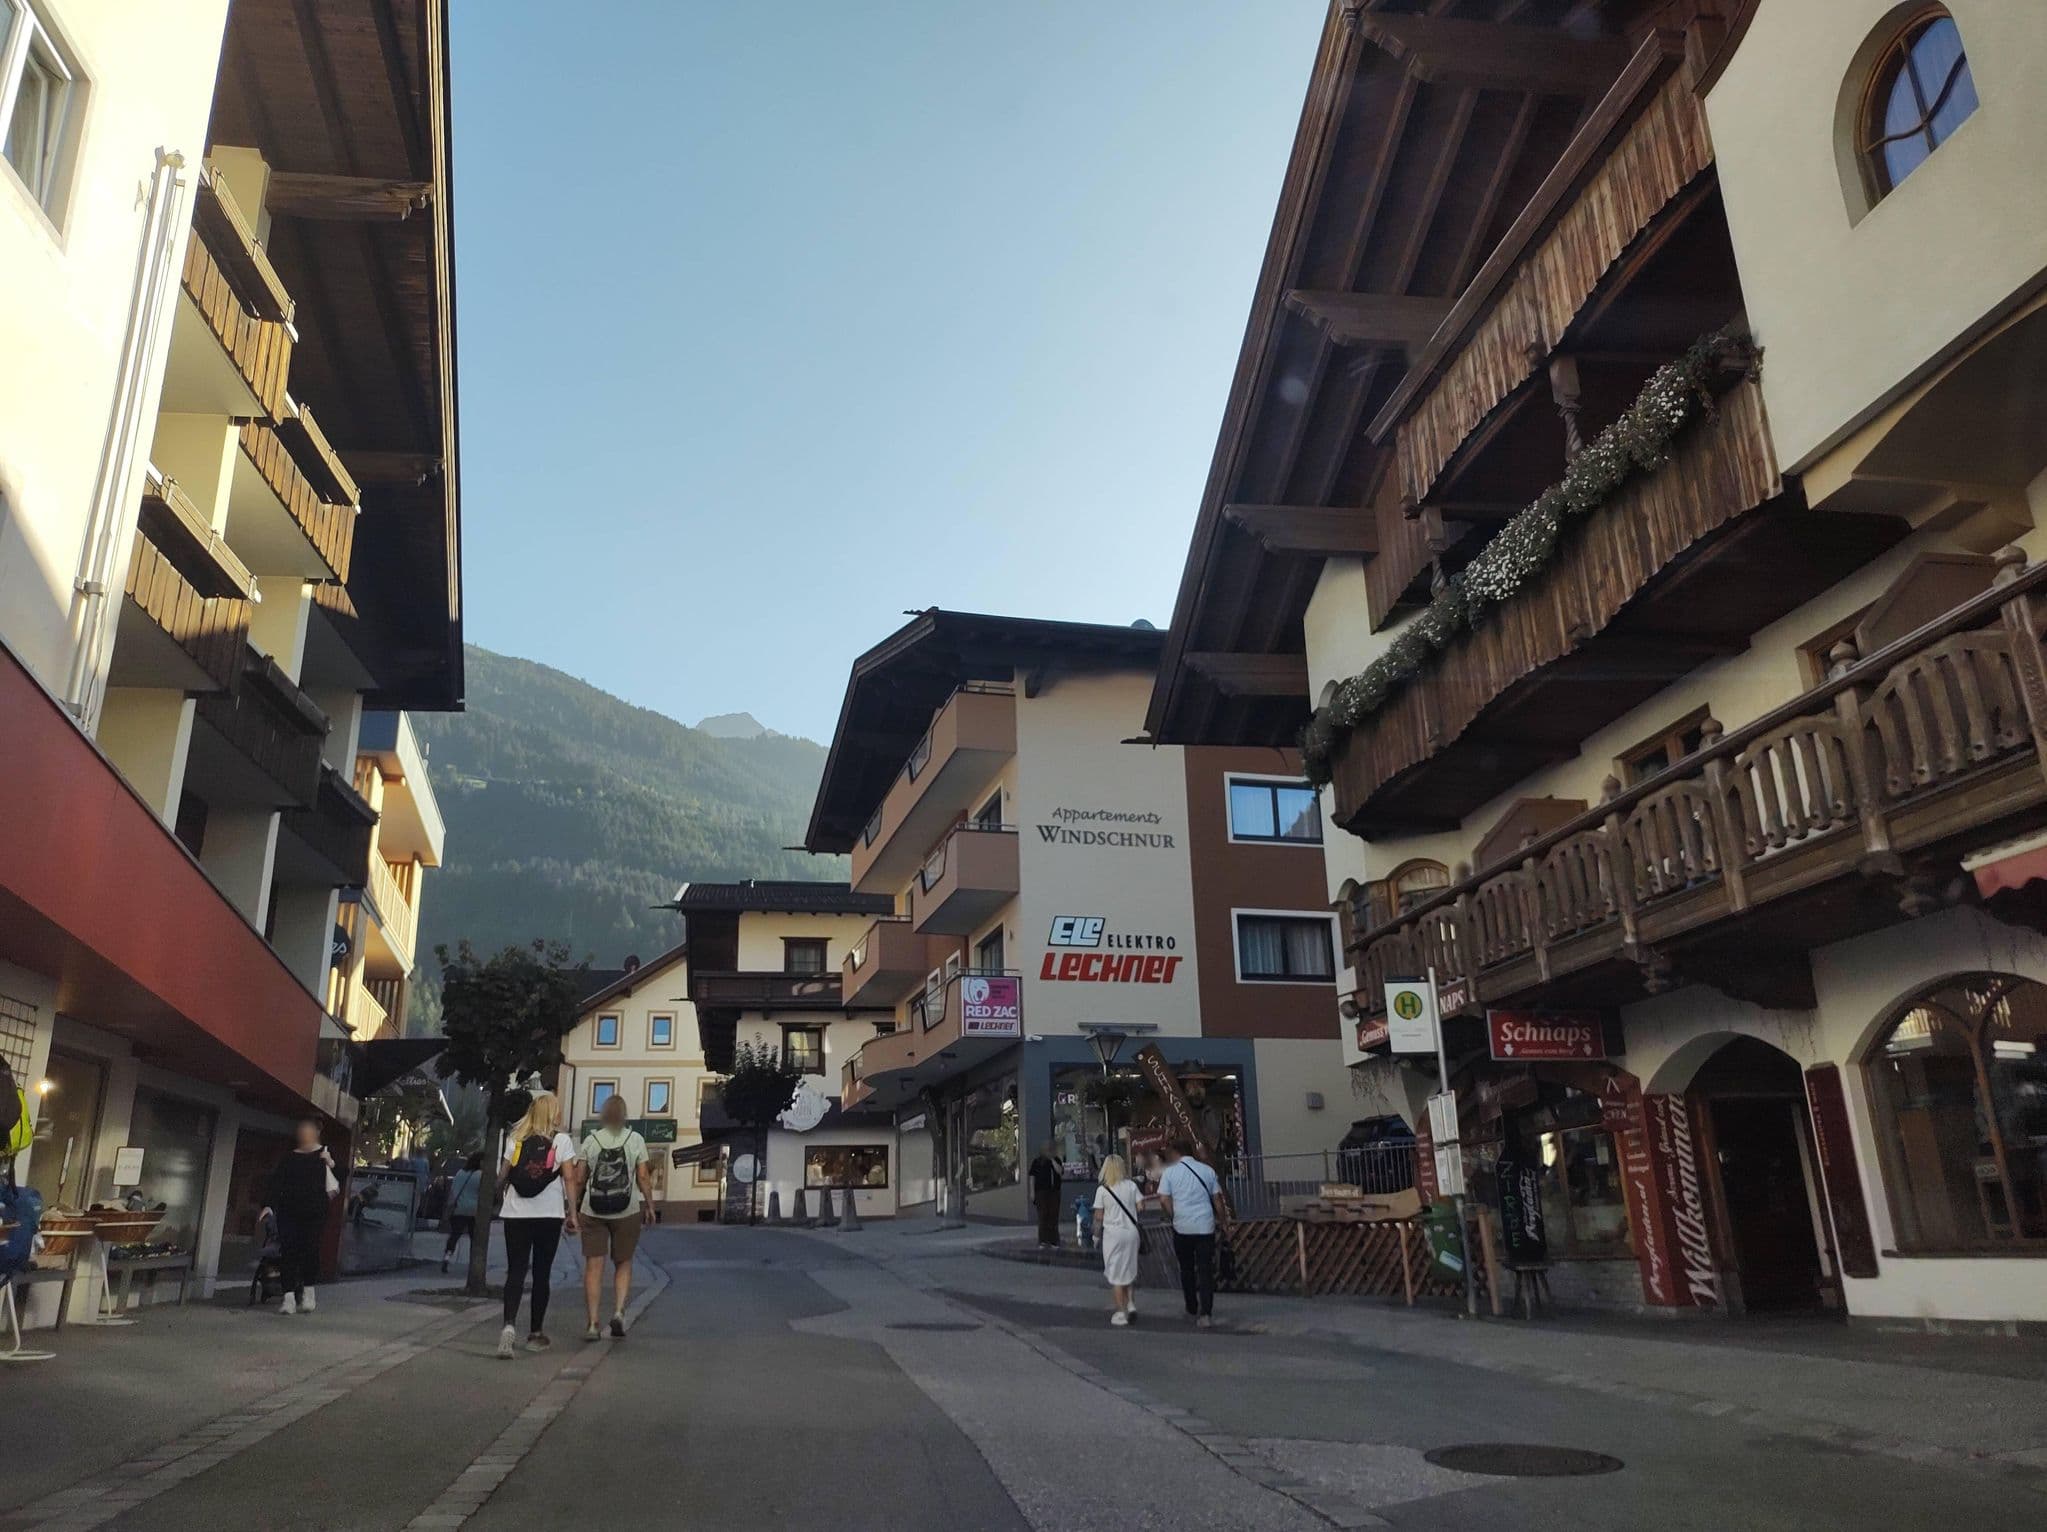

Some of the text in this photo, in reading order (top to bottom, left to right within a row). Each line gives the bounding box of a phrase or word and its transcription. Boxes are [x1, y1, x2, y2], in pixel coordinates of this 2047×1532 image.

[1052, 807, 1162, 825] Appartements
[1036, 824, 1176, 849] WINDSCHNUR
[1107, 934, 1176, 949] ELEKTRO
[966, 1005, 1017, 1018] RED ZAC
[1501, 1021, 1593, 1047] Schnaps
[1667, 1093, 1720, 1307] Willkommen
